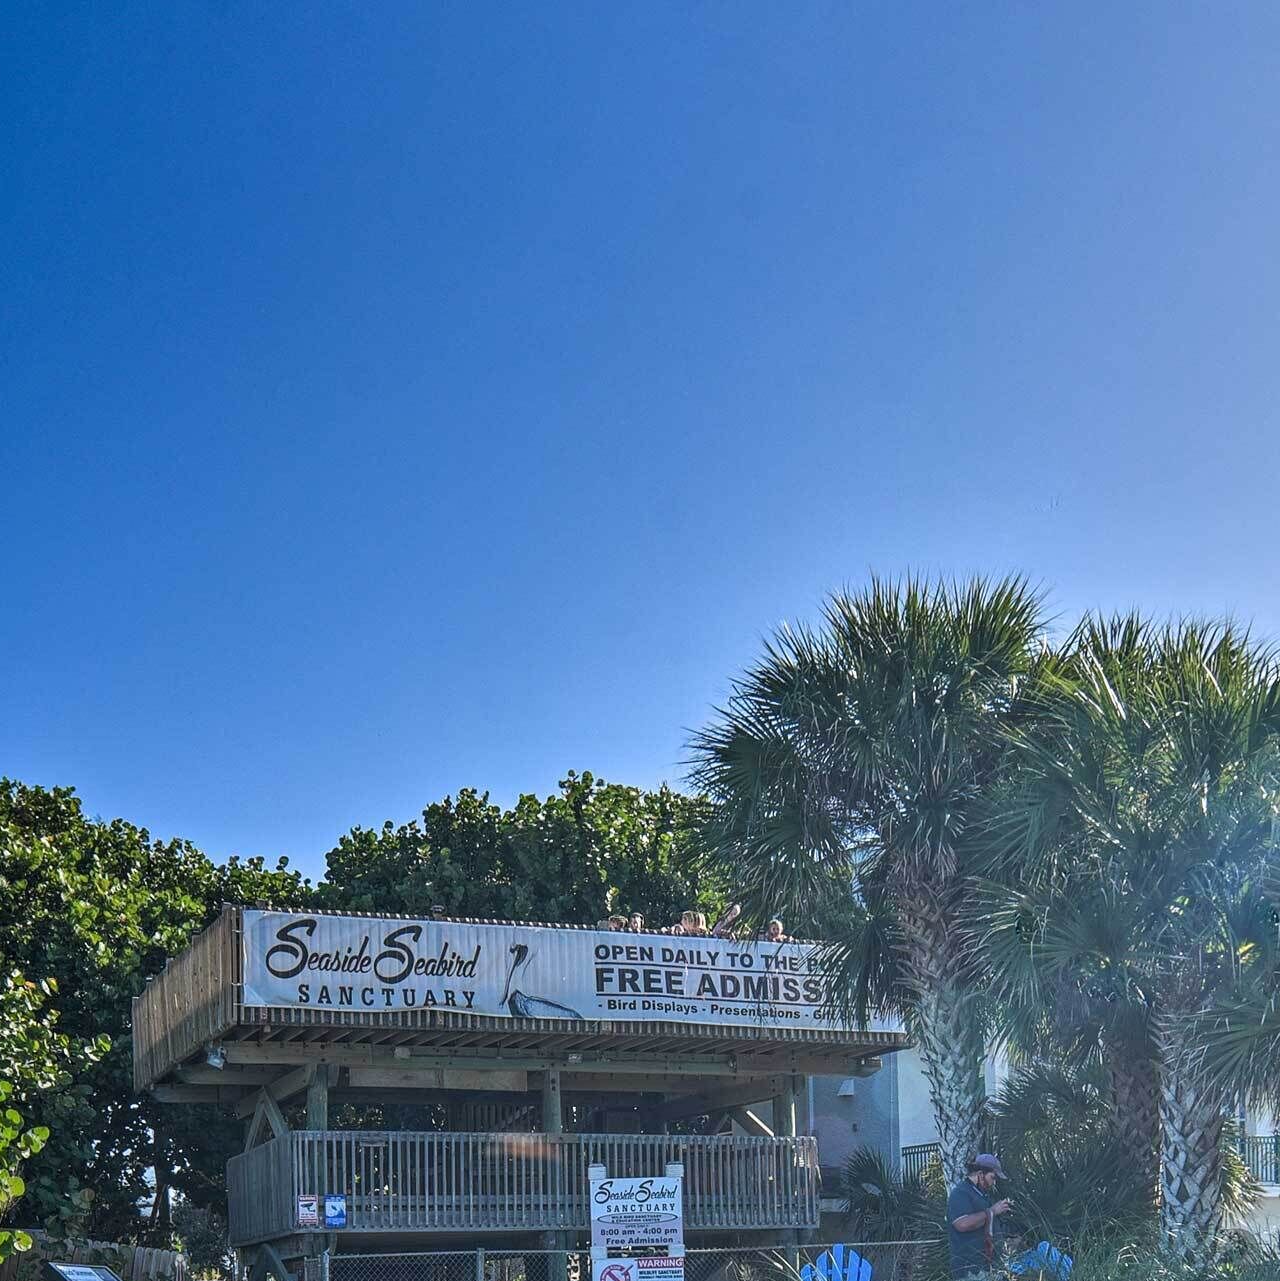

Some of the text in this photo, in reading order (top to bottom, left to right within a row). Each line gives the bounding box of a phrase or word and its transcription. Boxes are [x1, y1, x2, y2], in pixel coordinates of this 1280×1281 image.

[266, 919, 482, 985] Seaside Seabird
[594, 944, 654, 961] OPEN
[661, 947, 720, 966] DAILY
[726, 952, 754, 968] TO
[760, 954, 800, 971] THE
[298, 984, 477, 1009] SANCTUARY
[595, 967, 834, 1004] FREE ADMISS
[607, 999, 637, 1010] Bird
[641, 1000, 698, 1015] Displays
[710, 1004, 801, 1019] Presentations
[594, 1179, 678, 1204] Seaside Seabird
[606, 1203, 676, 1213] SANCTUARY
[606, 1236, 674, 1245] Free Admission
[642, 1227, 662, 1235] 4:00
[664, 1228, 678, 1236] pm
[638, 1258, 684, 1268] WARNING
